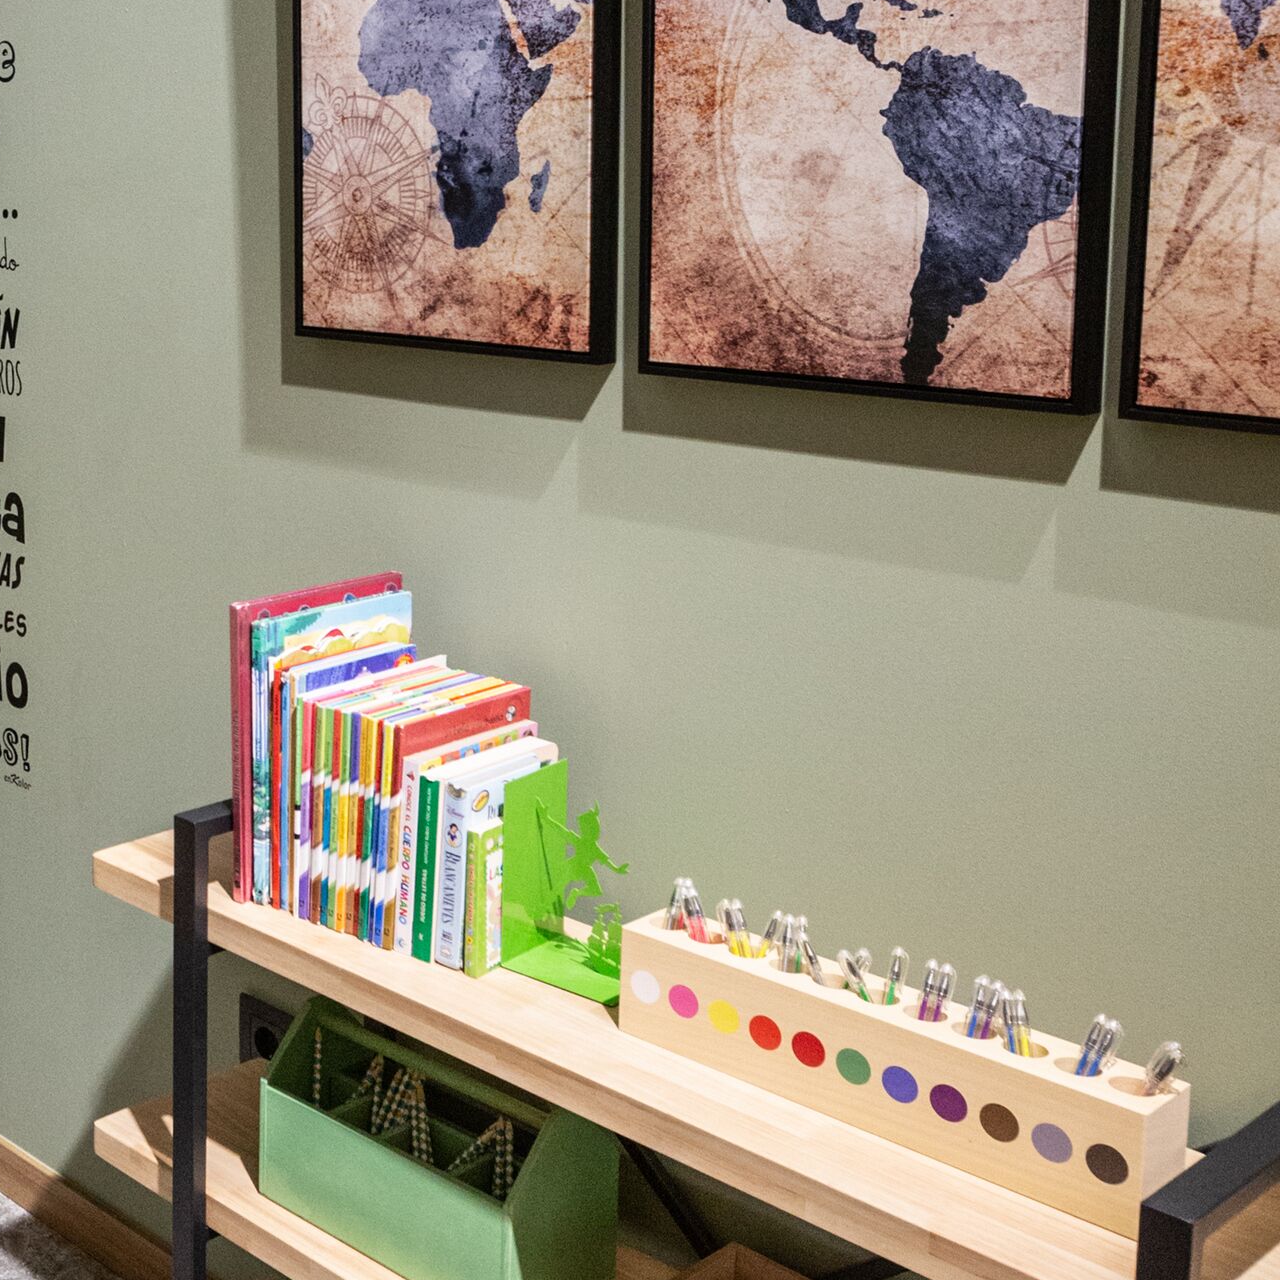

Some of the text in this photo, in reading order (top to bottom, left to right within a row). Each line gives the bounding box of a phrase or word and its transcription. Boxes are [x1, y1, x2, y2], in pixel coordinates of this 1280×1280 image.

[402, 824, 413, 870] CUERPO
[398, 874, 410, 926] HUMANO
[441, 850, 463, 926] BLANCANIEVES
